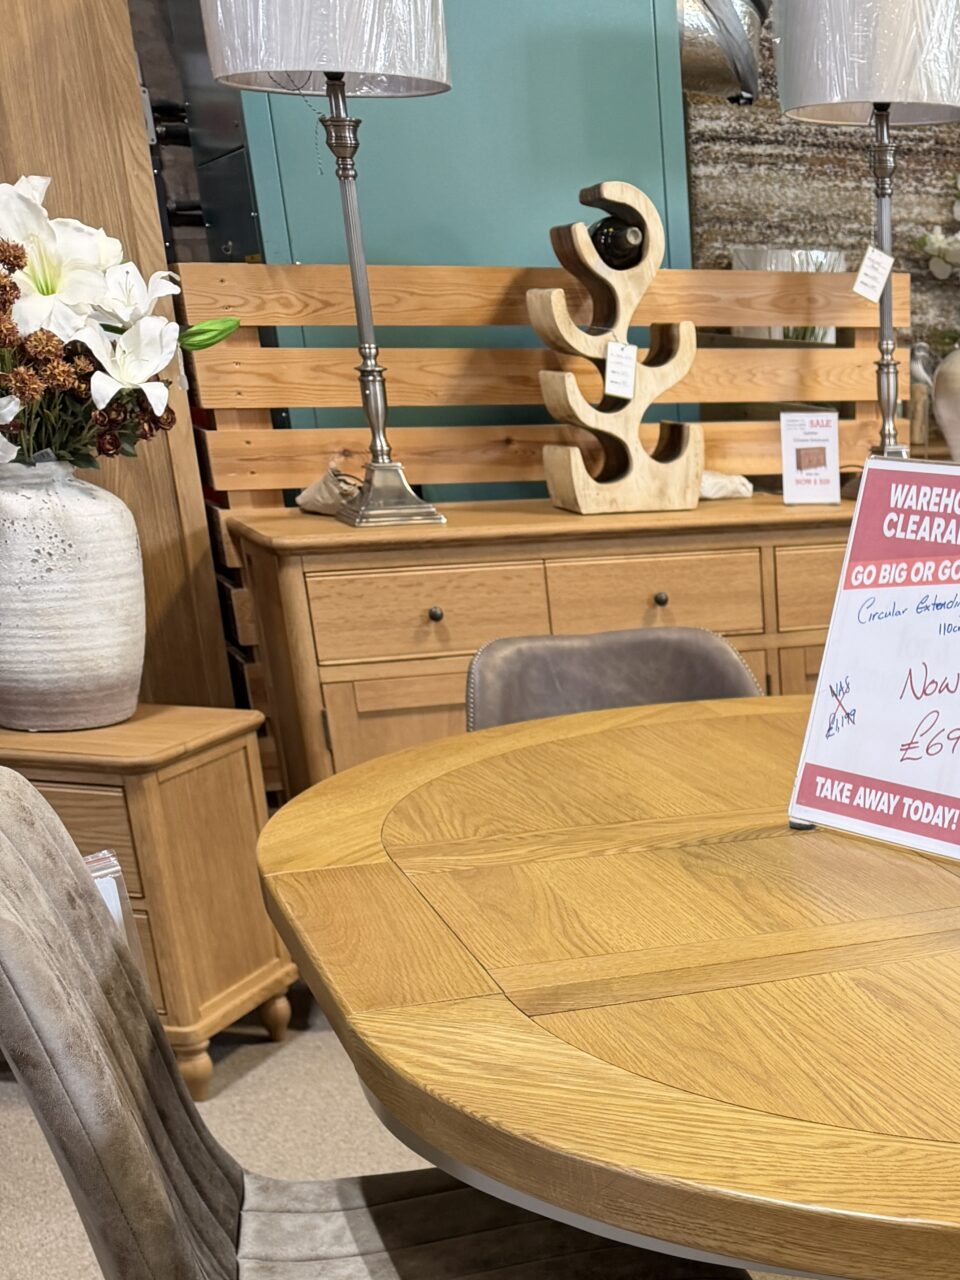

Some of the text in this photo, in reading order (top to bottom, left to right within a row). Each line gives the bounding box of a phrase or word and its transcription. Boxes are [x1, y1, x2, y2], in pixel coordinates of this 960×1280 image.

[851, 564, 876, 586] GO
[878, 562, 907, 584] BIG
[910, 561, 935, 582] OR
[857, 596, 908, 625] Circular
[815, 776, 960, 830] TAKE AWAY TODAY!
